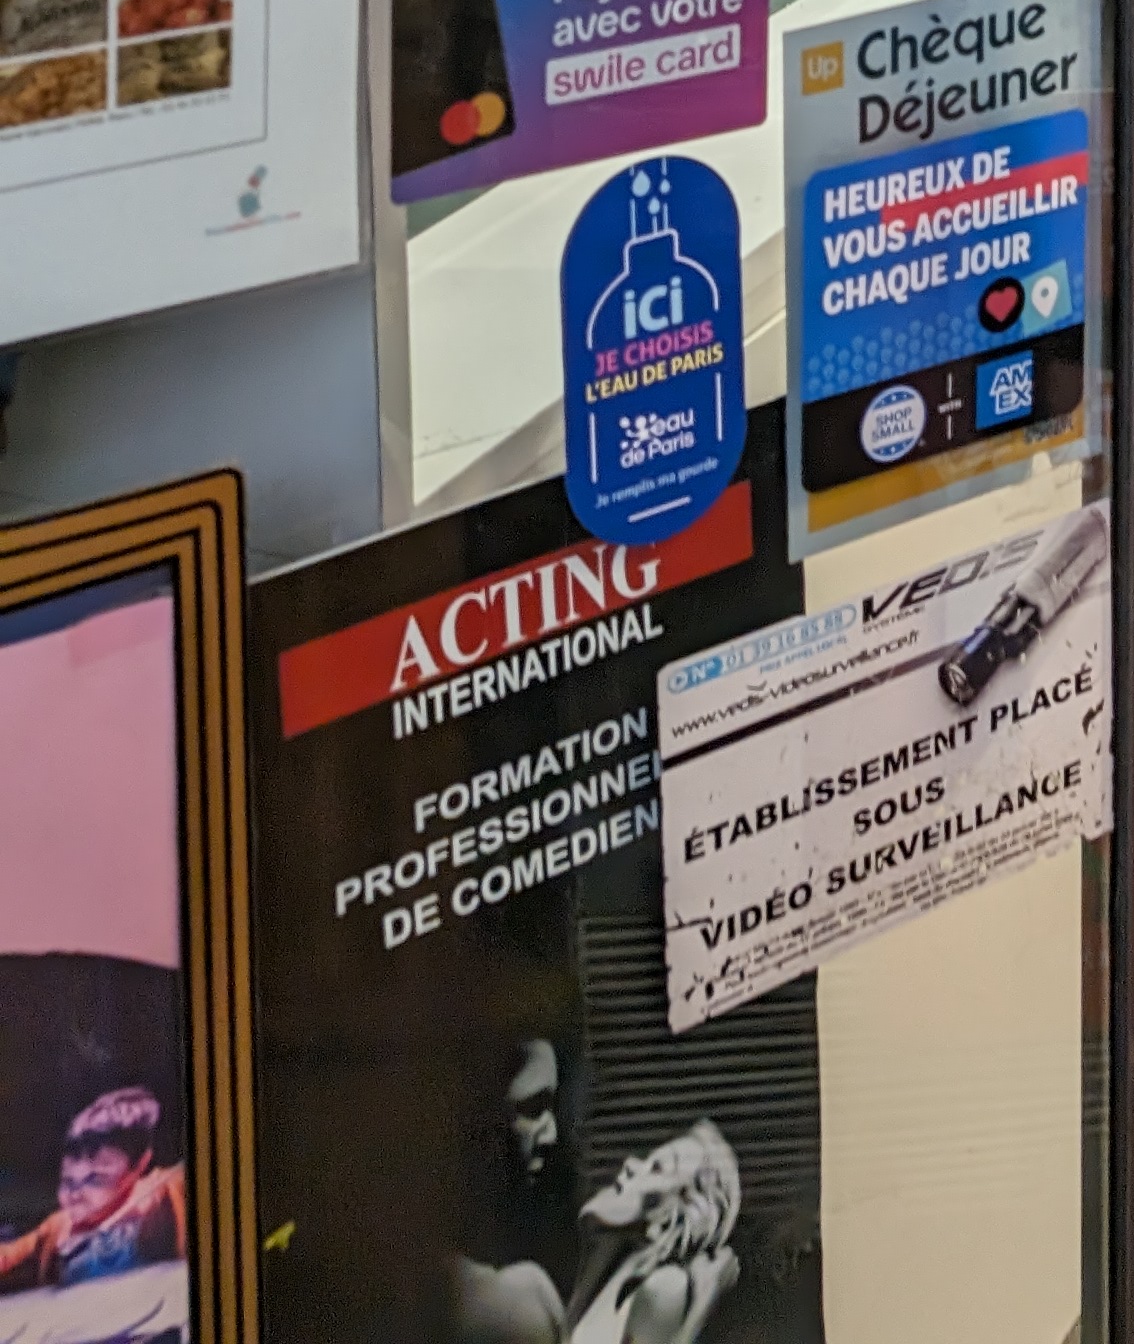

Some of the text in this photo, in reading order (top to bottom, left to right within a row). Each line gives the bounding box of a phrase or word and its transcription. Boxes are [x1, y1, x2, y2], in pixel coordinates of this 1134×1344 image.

[551, 5, 642, 48] avec
[856, 2, 1048, 80] Chèque
[552, 30, 736, 99] swile card
[858, 51, 1079, 145] Déjeuner
[823, 145, 1012, 224] HEUREUX DE
[822, 174, 1079, 269] VOUS ACCUEILLIR
[821, 231, 1032, 317] CHAQUE JOUR
[585, 343, 724, 405] L'EAU DE PARIS
[594, 347, 620, 377] JE
[619, 429, 695, 470] de Paris
[870, 420, 916, 443] SMALL
[875, 405, 913, 427] SHOP
[611, 478, 656, 504] remplis
[657, 472, 677, 488] ma
[390, 544, 662, 695] ACTING
[392, 602, 664, 740] INTERNATIONAL
[413, 706, 650, 835] FORMATION
[683, 663, 1096, 864] ÉTABLISSEMENT PLACÉ
[853, 776, 947, 837] SOUS
[699, 879, 813, 952] VIDÉO
[825, 758, 1084, 897] SURVEILLANCE
[382, 893, 442, 950] DE
